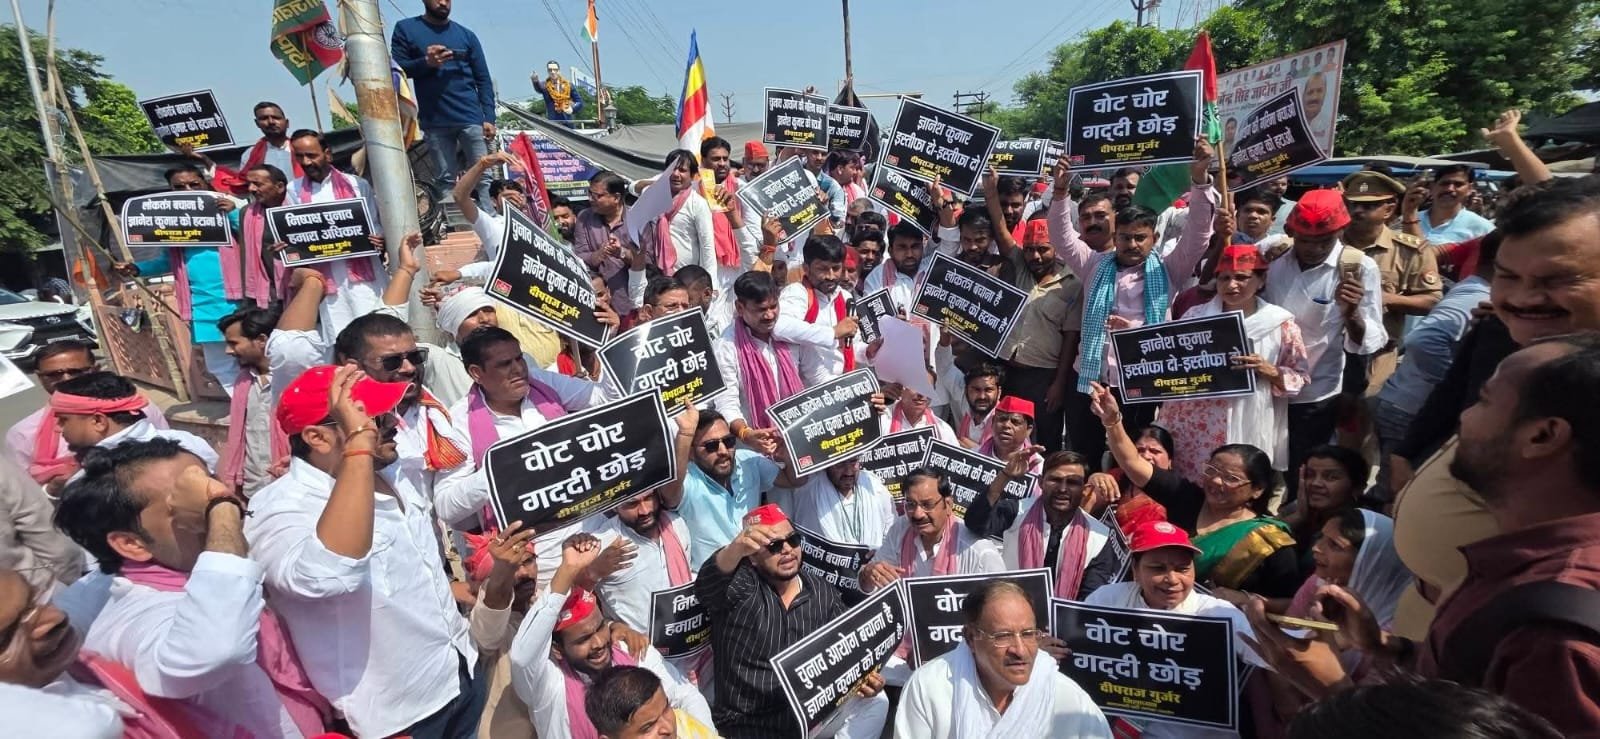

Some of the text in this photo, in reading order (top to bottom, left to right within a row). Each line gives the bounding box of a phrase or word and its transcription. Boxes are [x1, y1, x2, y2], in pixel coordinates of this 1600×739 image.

[1093, 87, 1169, 114] वोट चोर
[917, 115, 973, 145] ज्ञानेश कुमार
[1082, 113, 1179, 141] गद्दी छोड़
[894, 131, 926, 152] इस्तीफा
[969, 155, 980, 172] दो
[1100, 139, 1160, 153] दीपराज गुर्जर
[142, 197, 204, 210] लोकतंत्र बचाना है
[128, 213, 223, 229] ज्ञानेश कुमार को हटाना है
[285, 209, 354, 227] निष्पक्ष चुनाव
[286, 225, 364, 244] हमारा अधिकार
[512, 218, 532, 244] चुनाव
[533, 235, 556, 259] आयोग
[521, 254, 547, 281] ज्ञानेश
[546, 268, 568, 292] कुमार
[568, 278, 579, 299] को
[945, 268, 1003, 306] लोकतंत्र बचाना है
[529, 285, 561, 309] दीपराज
[924, 283, 949, 301] ज्ञानेश
[948, 293, 969, 311] कुमार
[969, 302, 980, 317] को
[978, 309, 1000, 329] हटाना
[998, 317, 1008, 333] है
[630, 326, 694, 359] वोट चोर
[1139, 330, 1214, 355] ज्ञानेश कुमार
[680, 350, 708, 373] छोड़
[1123, 358, 1164, 379] इस्तीफा
[686, 376, 704, 394] गुर्जर
[1153, 374, 1212, 387] दीपराज गुर्जर
[778, 406, 801, 424] चुनाव
[802, 419, 825, 442] ज्ञानेश
[823, 414, 844, 436] कुमार
[843, 407, 854, 425] को
[521, 422, 626, 472] वोट चोर
[873, 443, 896, 460] आयोग
[896, 440, 920, 455] बचाना
[518, 466, 593, 512] गद्दी
[597, 448, 647, 481] छोड़
[874, 466, 896, 484] कुमार
[896, 460, 908, 476] को
[948, 458, 972, 478] आयोग
[970, 464, 983, 482] की
[955, 483, 977, 502] कुमार
[801, 536, 860, 570] ोकतंत्र बचाना है
[826, 570, 839, 585] को
[665, 613, 703, 636] हमारा
[1084, 618, 1187, 652] वोट चोर
[794, 652, 828, 689] चुनाव
[826, 632, 860, 666] आयोग
[857, 611, 886, 642] बचाना
[882, 601, 893, 624] है
[804, 683, 836, 719] ज्ञानेश
[835, 663, 862, 694] कुमार
[860, 648, 874, 671] को
[1073, 653, 1204, 691] गद्दी छोड़
[1099, 681, 1181, 703] दीपराज गुर्जर
